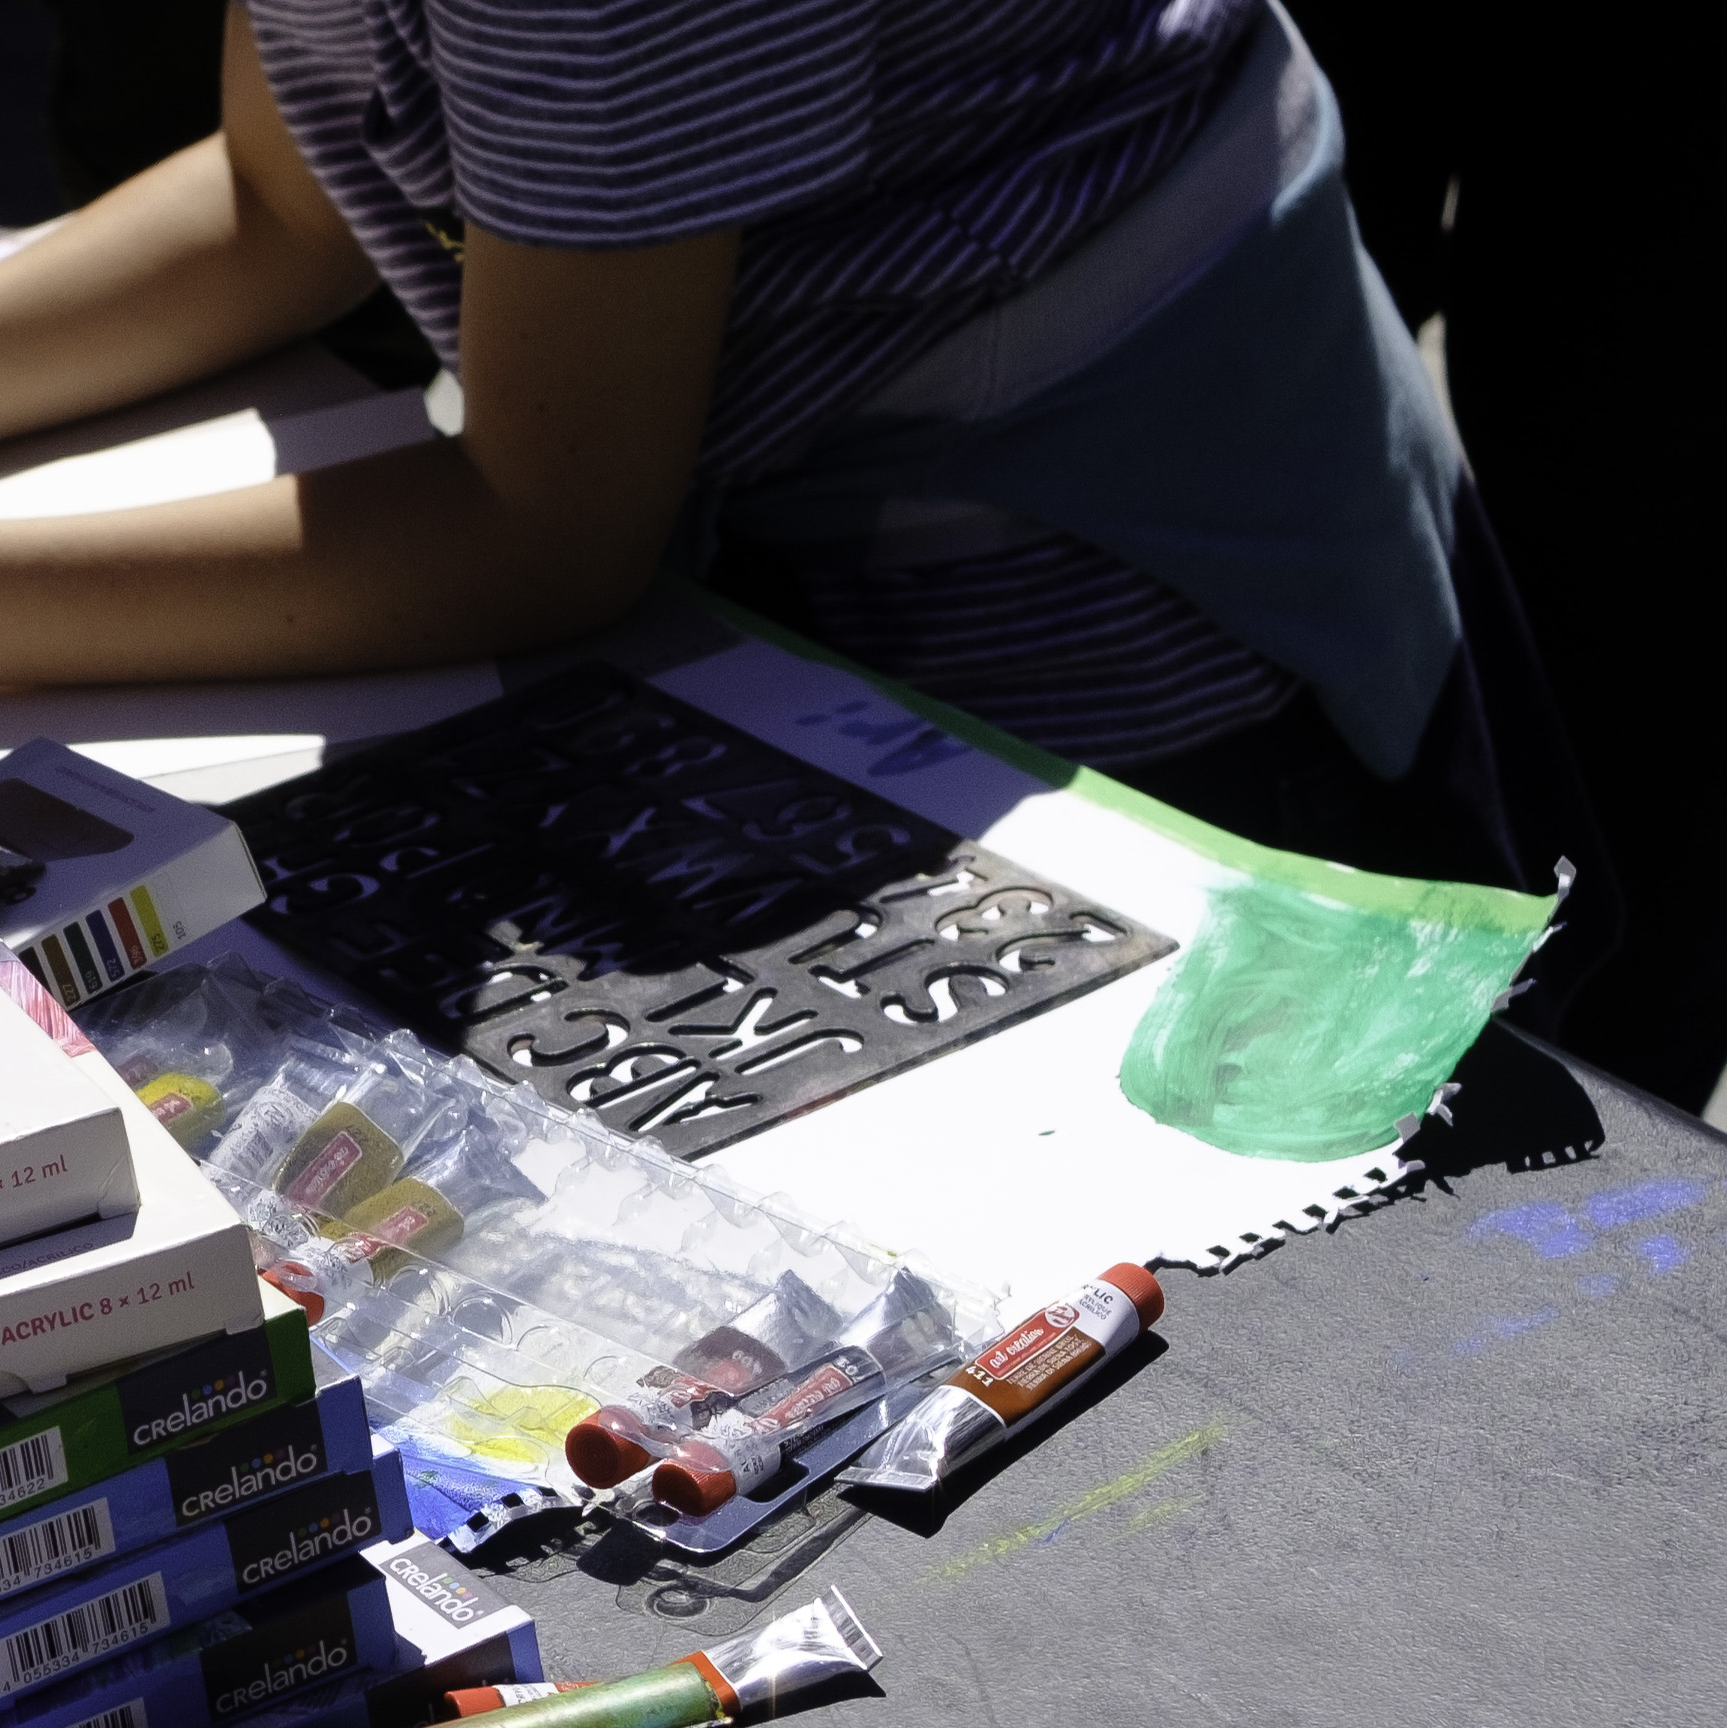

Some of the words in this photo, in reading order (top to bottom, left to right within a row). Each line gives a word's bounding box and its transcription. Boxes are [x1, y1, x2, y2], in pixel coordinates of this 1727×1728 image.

[11, 1164, 35, 1190] 12
[41, 1155, 68, 1180] ml
[0, 1302, 95, 1346] ACRYLIC
[99, 1297, 114, 1316] 8
[136, 1283, 164, 1306] 12
[169, 1272, 195, 1297] ml
[32, 1546, 94, 1578] 734615
[1, 1678, 13, 1694] 4
[23, 1652, 80, 1685] 055334
[90, 1620, 150, 1654] 734615
